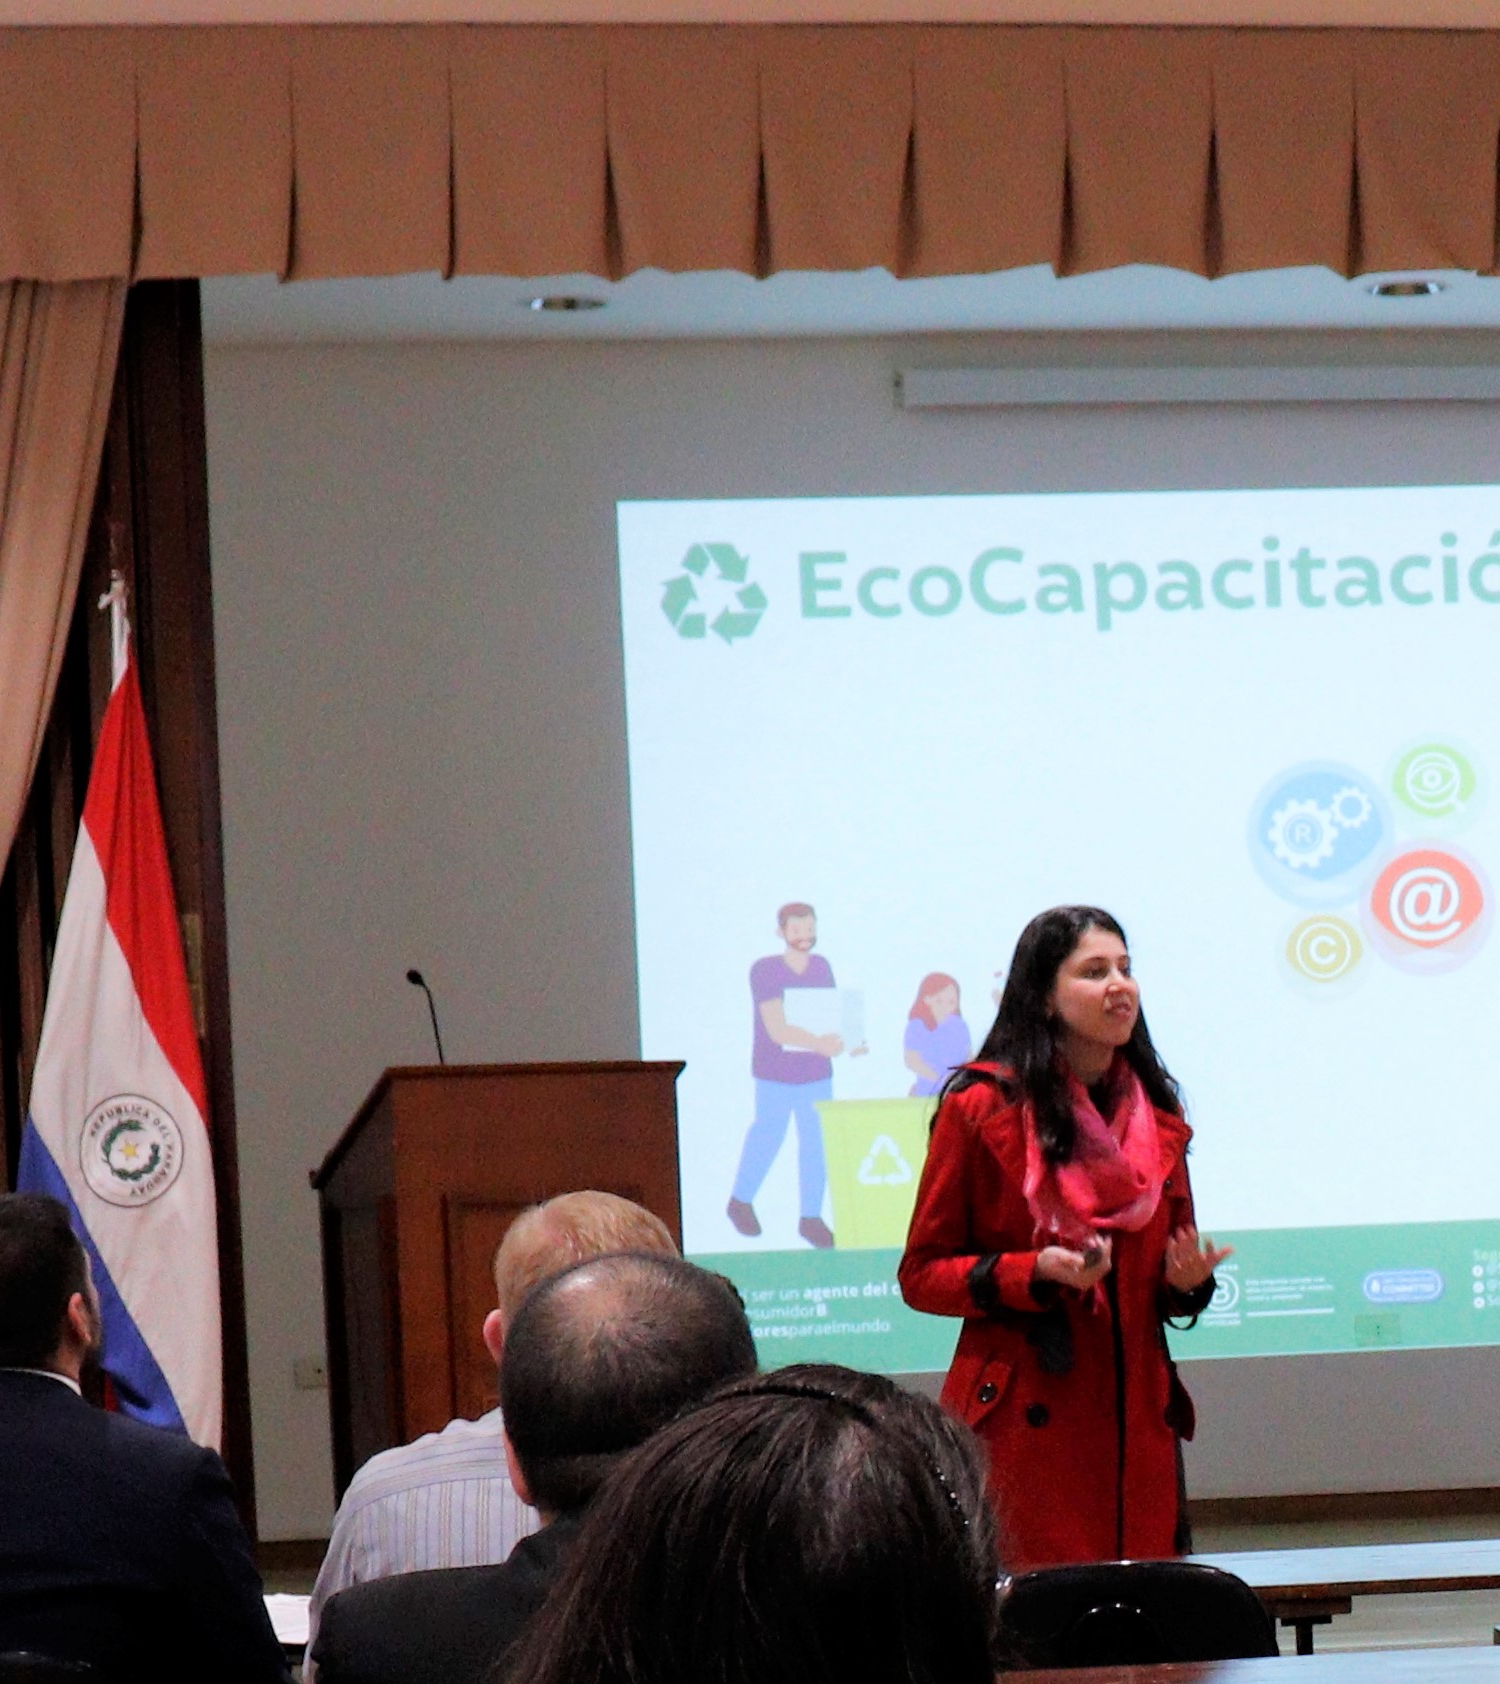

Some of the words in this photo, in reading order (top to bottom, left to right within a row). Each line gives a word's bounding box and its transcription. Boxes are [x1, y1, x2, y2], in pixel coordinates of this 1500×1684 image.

[779, 1287, 799, 1299] un
[803, 1284, 859, 1301] agente
[862, 1282, 887, 1297] del
